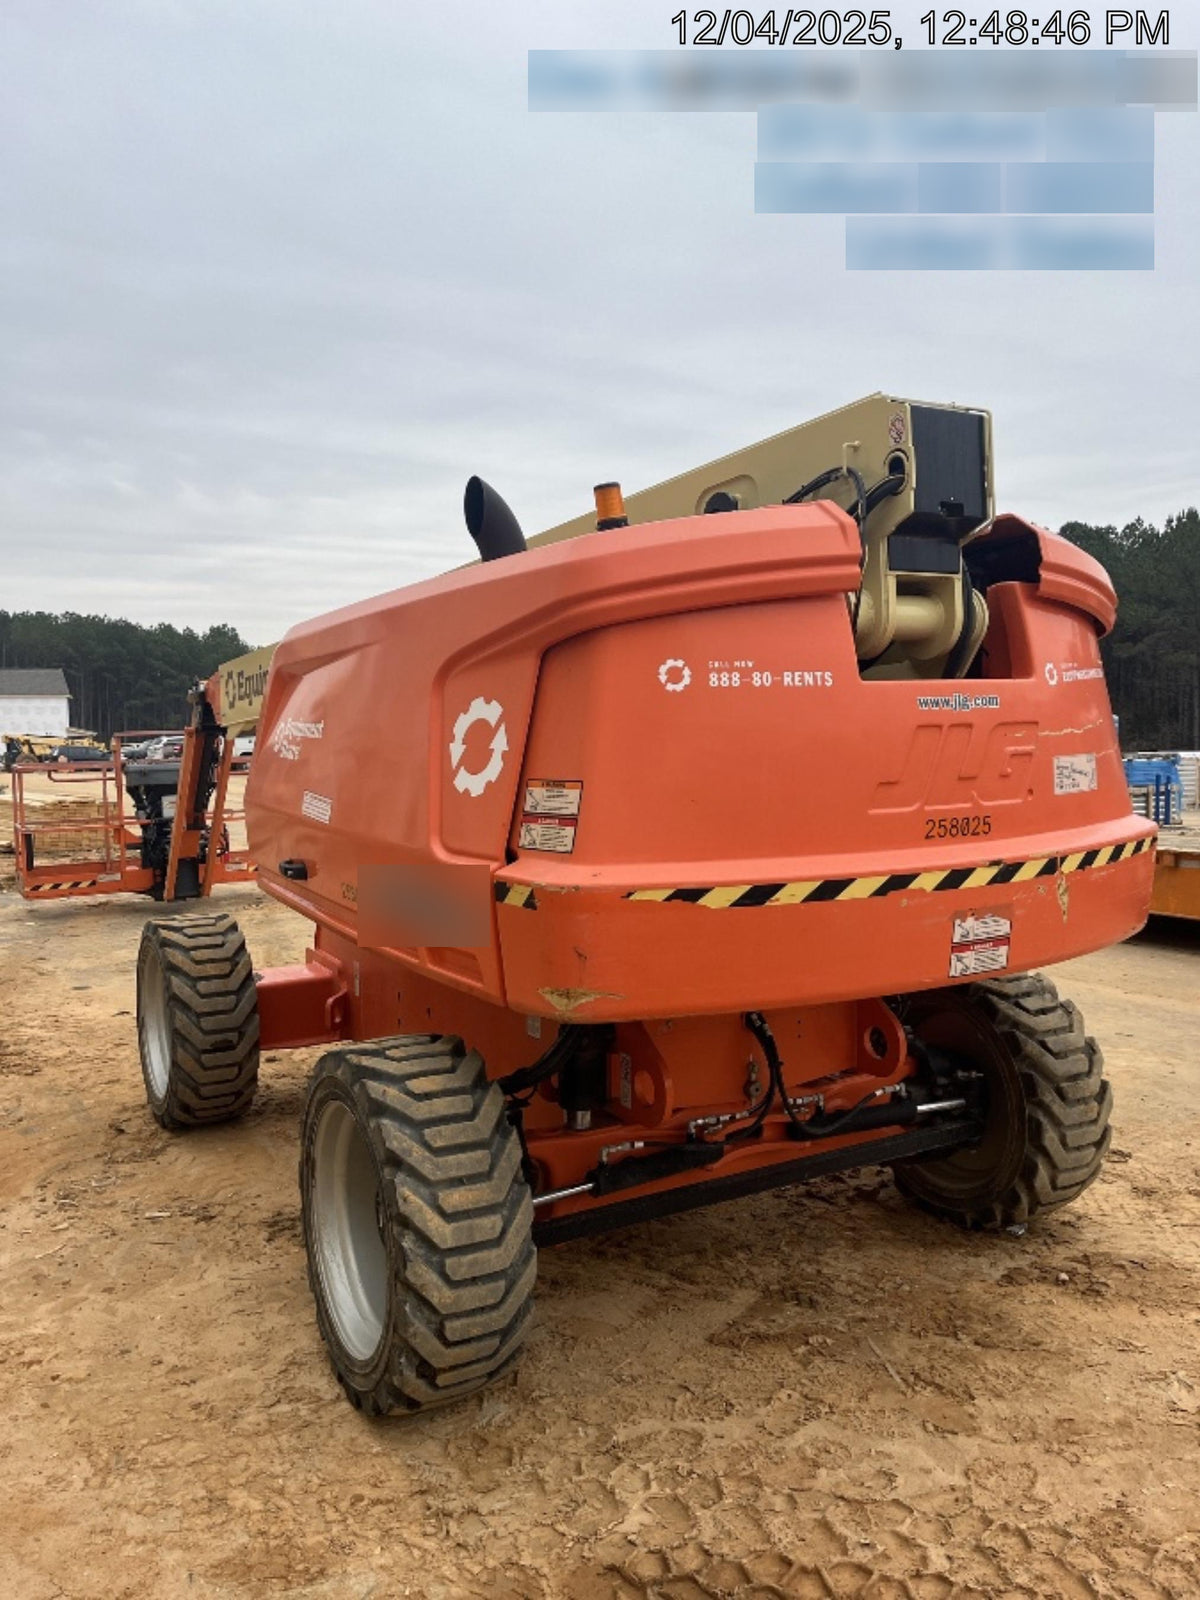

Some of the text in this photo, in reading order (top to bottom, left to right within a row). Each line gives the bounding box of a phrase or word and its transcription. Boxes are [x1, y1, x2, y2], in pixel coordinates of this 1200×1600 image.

[708, 671, 833, 687] 888-80-RENTS
[917, 694, 1000, 711] www.jlg.com
[868, 720, 1039, 814] JLG
[924, 815, 992, 840] 258025
